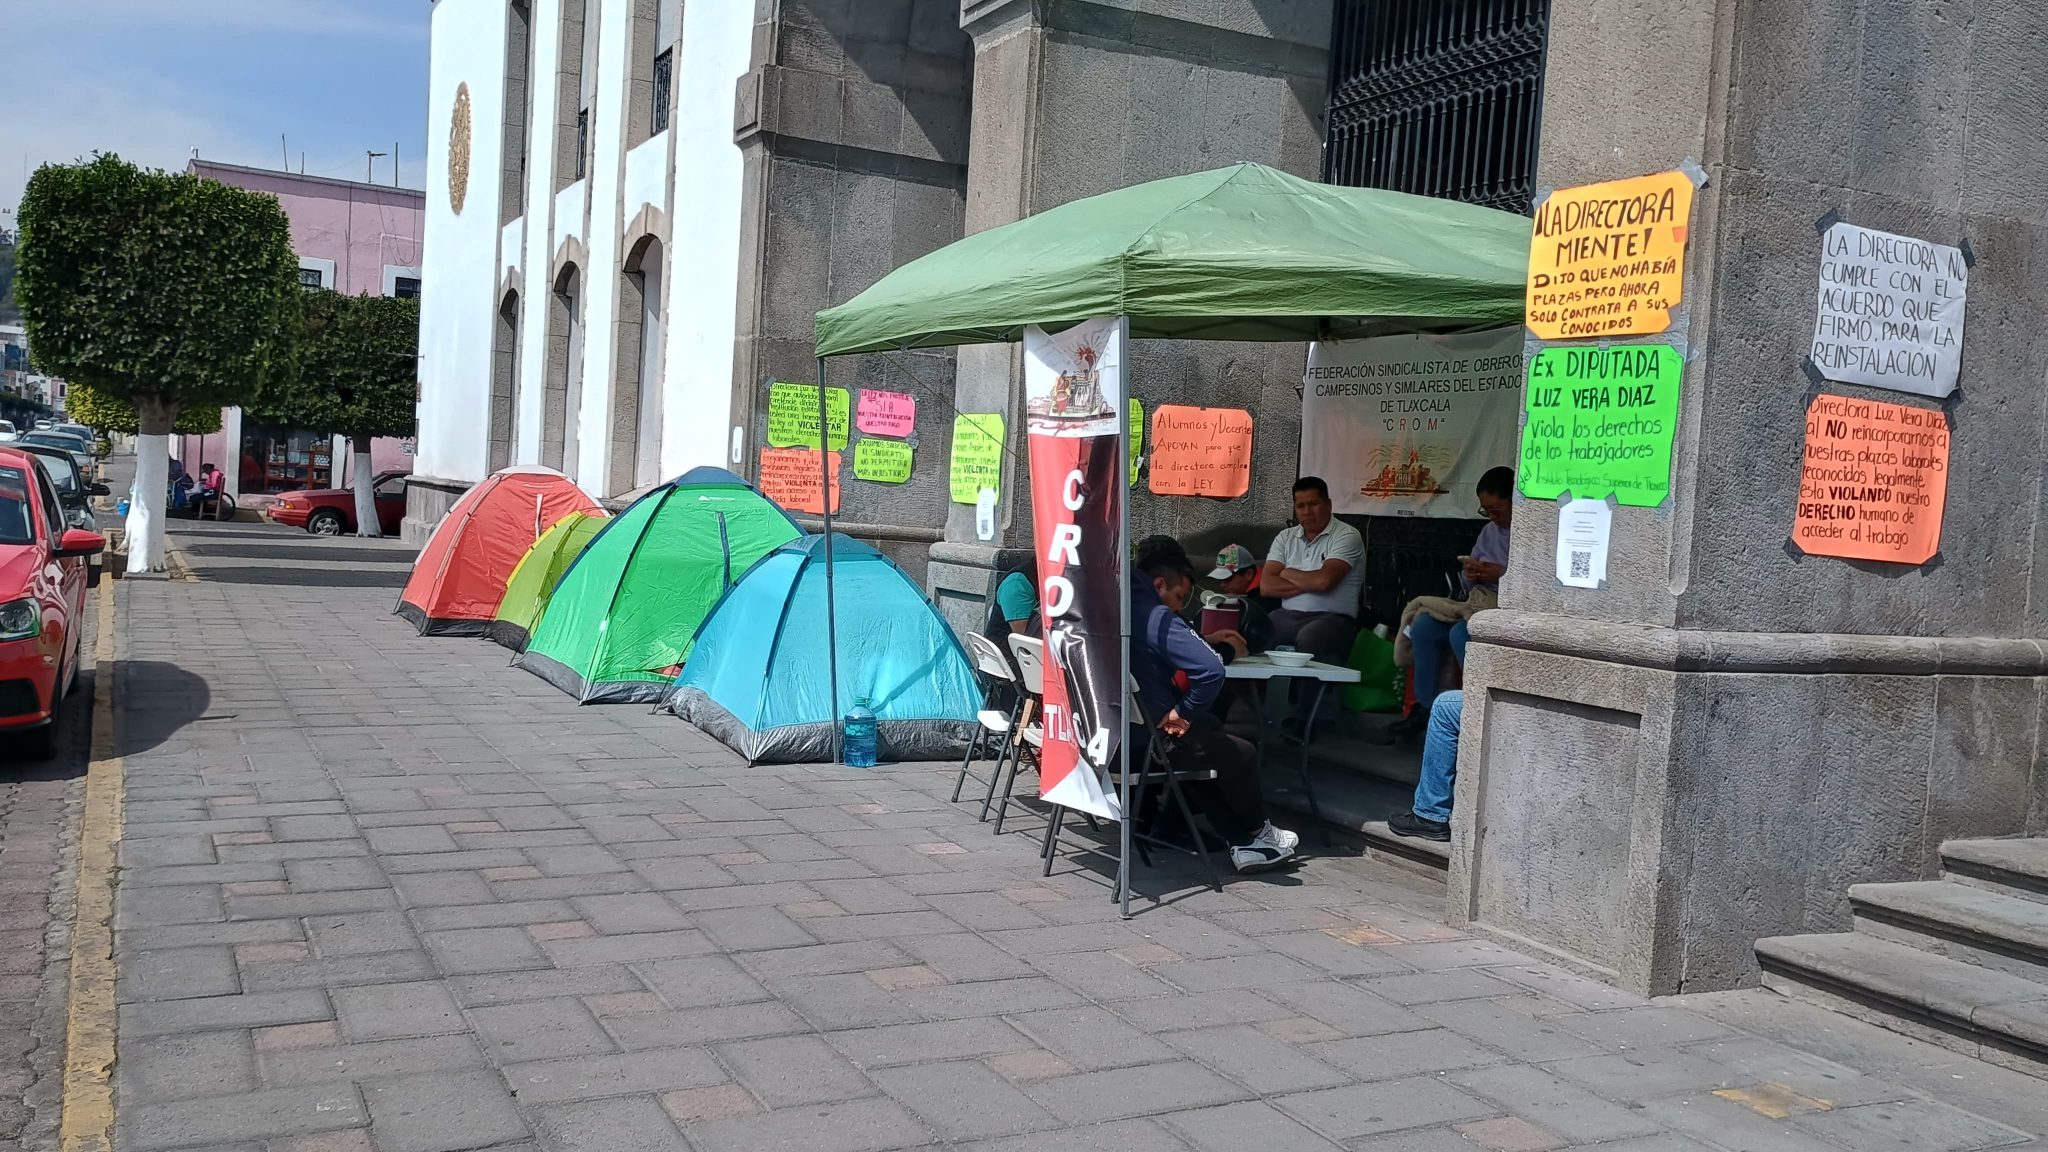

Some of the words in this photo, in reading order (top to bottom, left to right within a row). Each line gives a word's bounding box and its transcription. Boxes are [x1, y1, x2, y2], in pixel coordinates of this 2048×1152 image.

[1556, 228, 1653, 267] MIENTE!
[1827, 229, 1849, 258] LA
[1858, 231, 1939, 273] DIRECTORA
[1533, 271, 1576, 289] DIJO
[1580, 267, 1607, 283] QUE
[1609, 264, 1629, 280] NO
[1630, 256, 1676, 276] HABÍA
[1821, 262, 1880, 289] CUMPLE
[1889, 271, 1921, 293] CON
[1934, 278, 1953, 299] EL
[1533, 292, 1582, 306] PLAZAS
[1584, 286, 1616, 300] PERO
[1618, 280, 1660, 297] AHORA
[1821, 288, 1894, 318] ACUERDO
[1902, 299, 1941, 322] QUE
[1530, 310, 1557, 323] SOLO
[1561, 302, 1621, 321] CONTRATA
[1627, 299, 1638, 312] A
[1646, 298, 1669, 311] SUS
[1560, 317, 1633, 335] CONOCIDOS
[1882, 321, 1920, 343] PARA
[1933, 326, 1956, 347] LA
[1308, 362, 1375, 380] FEDERACIÓN
[1378, 360, 1449, 377] SINDICALISTA
[1452, 359, 1469, 374] DE
[1566, 350, 1660, 379] DIPUTADA
[1813, 341, 1936, 381] REINSTALACIÓN
[1315, 382, 1383, 397] CAMPESINOS
[1385, 382, 1393, 394] Y
[1453, 378, 1475, 392] DEL
[1478, 374, 1522, 391] ESTADO
[1532, 387, 1562, 408] LUZ
[1572, 387, 1610, 411] VERA
[1617, 384, 1656, 408] DIAZ
[1380, 400, 1394, 413] DE
[1397, 398, 1451, 413] TLAXCALA
[1810, 398, 1869, 419] Directora
[1875, 402, 1894, 422] Luz
[1900, 408, 1922, 426] Vera
[797, 421, 842, 432] VIOLETAR
[1157, 413, 1208, 430] Alumnos
[1210, 422, 1218, 441] y
[1531, 416, 1564, 439] Viola
[1572, 414, 1590, 438] los
[1594, 413, 1662, 440] derechos
[1806, 416, 1819, 439] al
[1825, 420, 1847, 439] NO
[1852, 426, 1935, 449] reincorporarnos
[1937, 434, 1946, 449] a
[1525, 440, 1541, 460] de
[1546, 441, 1562, 460] los
[1568, 439, 1654, 465] trabajadores
[1804, 442, 1854, 462] nuestras
[1858, 446, 1898, 468] plazas
[1902, 448, 1944, 472] laborales
[1171, 461, 1215, 471] directora
[1519, 465, 1532, 490] del
[1874, 467, 1925, 489] legalmente
[1155, 480, 1171, 488] con
[1178, 477, 1187, 488] la
[1193, 478, 1214, 490] LEY
[1800, 482, 1824, 499] esta
[1829, 486, 1891, 502] VIOLANDO
[1896, 493, 1930, 507] nuestro
[1799, 503, 1855, 520] DERECHO
[1859, 504, 1899, 522] humano
[1902, 507, 1914, 524] de
[1801, 522, 1844, 538] acceder
[1850, 522, 1861, 542] al
[1866, 525, 1909, 550] trabajo
